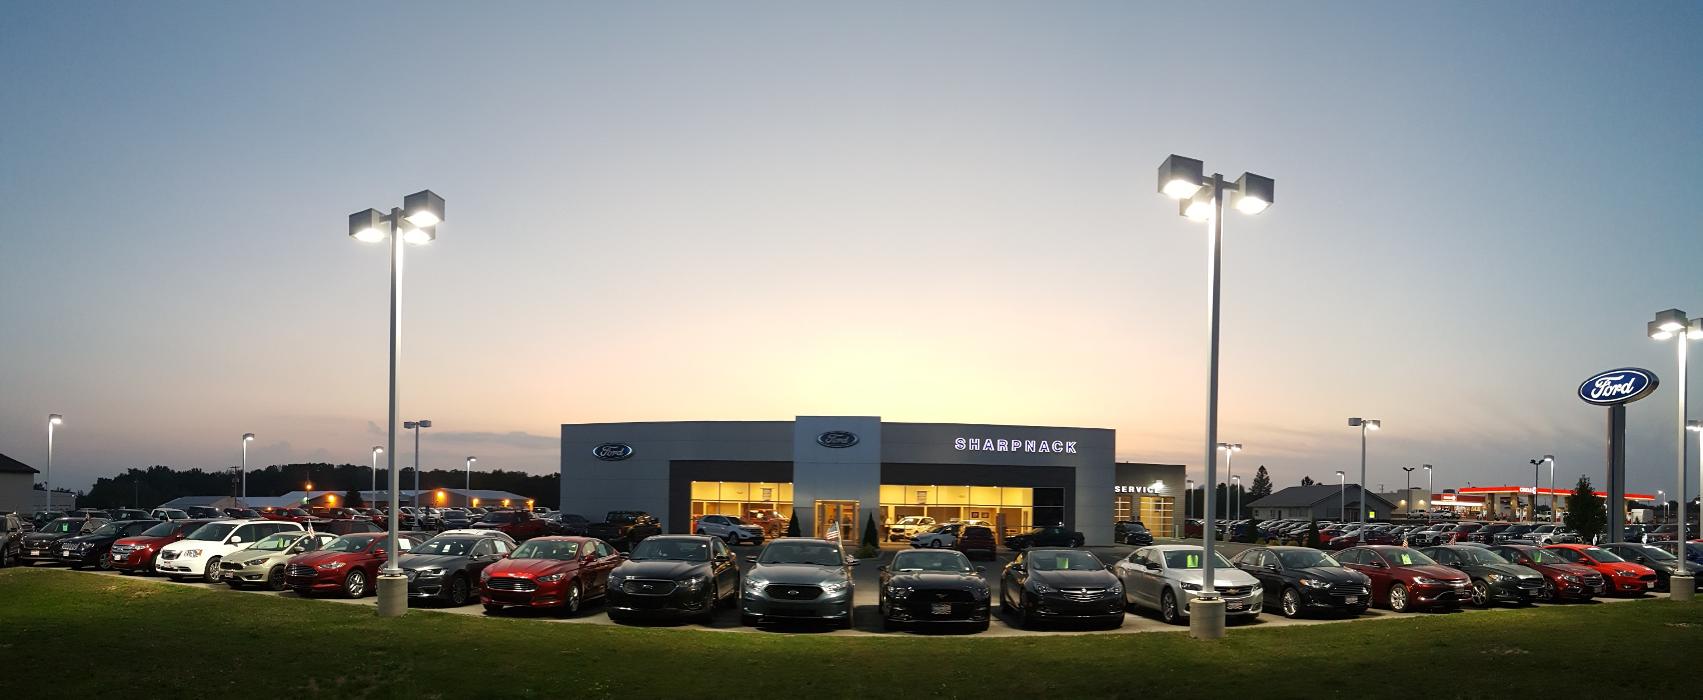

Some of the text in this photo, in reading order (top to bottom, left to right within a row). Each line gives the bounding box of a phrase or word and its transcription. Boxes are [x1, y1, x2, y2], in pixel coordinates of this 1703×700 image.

[1590, 375, 1636, 398] Ford
[600, 445, 625, 457] Ford
[954, 437, 1077, 454] SHARPNACK
[1114, 485, 1161, 494] SERVICE
